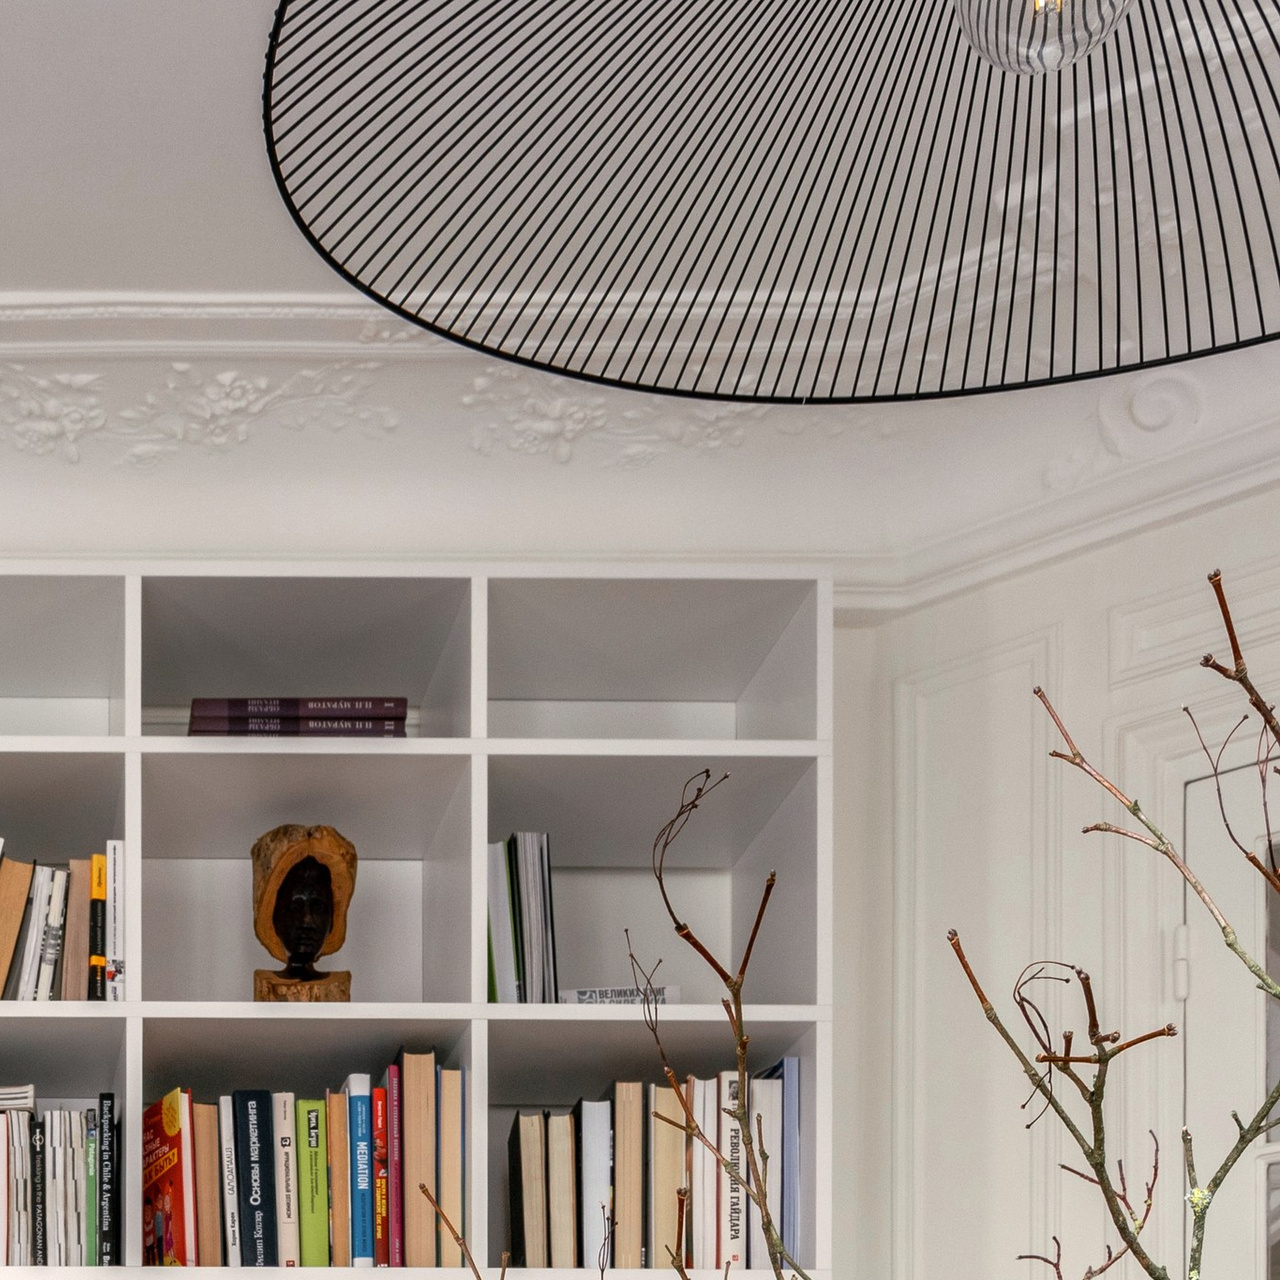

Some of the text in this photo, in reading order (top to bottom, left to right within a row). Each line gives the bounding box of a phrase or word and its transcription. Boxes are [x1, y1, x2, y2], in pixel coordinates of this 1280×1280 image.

[308, 701, 352, 709] МУРАТОВ
[308, 719, 352, 728] МУРАТОВ
[598, 987, 640, 999] ВЕЛИКИХ
[101, 1100, 112, 1150] Backpacking
[34, 1154, 42, 1183] Trekking
[87, 1143, 96, 1176] Patagonia
[103, 1151, 111, 1160] in
[103, 1161, 111, 1183] Chile
[247, 1101, 264, 1238] Котлер Основы маркетинга
[356, 1142, 369, 1190] MEDIATION
[225, 1147, 238, 1247] Хорни Карен САМОАНАЛИЗ
[728, 1128, 740, 1240] РЕВОЛЮИЯ ГАЙДАРА
[35, 1204, 43, 1249] PATAGONIAN
[101, 1191, 112, 1231] Argentina
